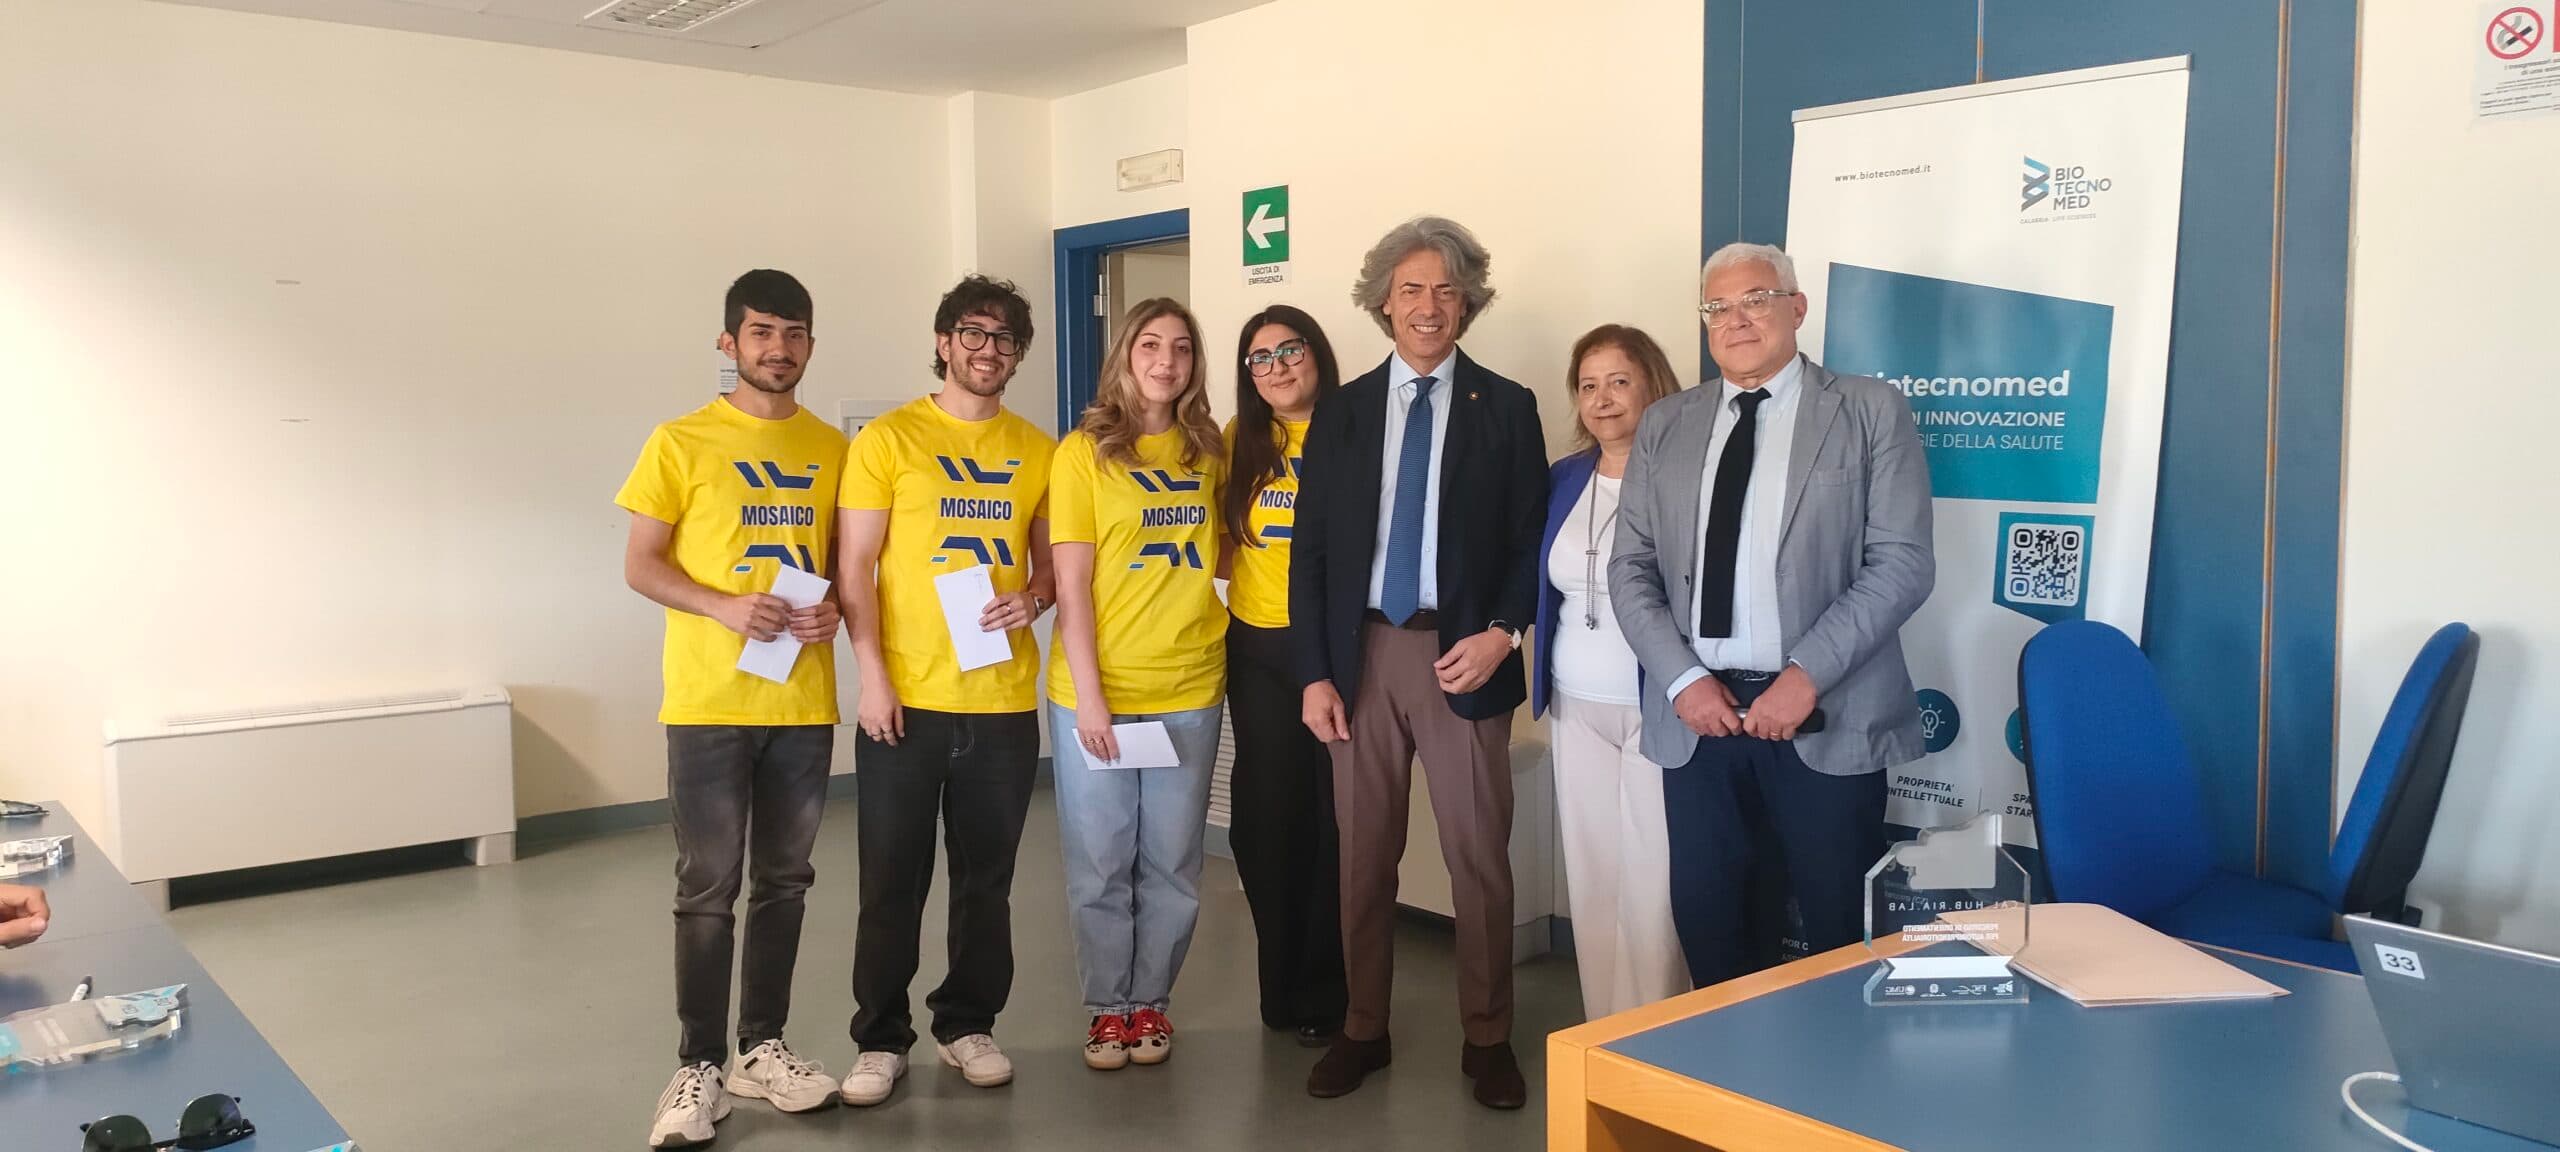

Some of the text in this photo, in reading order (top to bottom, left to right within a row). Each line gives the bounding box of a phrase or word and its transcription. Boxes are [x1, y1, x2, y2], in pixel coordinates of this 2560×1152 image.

[1834, 164, 1931, 182] www.biotecnomed.it
[2055, 166, 2085, 181] BIO
[2054, 178, 2112, 195] TECNO
[2053, 195, 2091, 211] MED
[1252, 266, 1272, 275] USCITA
[1863, 370, 2070, 397] tecnomed
[1925, 411, 2066, 427] INNOVAZIONE
[1943, 433, 1996, 449] DELLA
[2000, 434, 2064, 451] SALUTE
[741, 505, 814, 527] MOSAICO
[940, 497, 1012, 521] MOSAICO
[1142, 505, 1206, 527] MOSAICO
[1896, 775, 1955, 793] PROPRIETA'
[2385, 953, 2416, 971] 33
